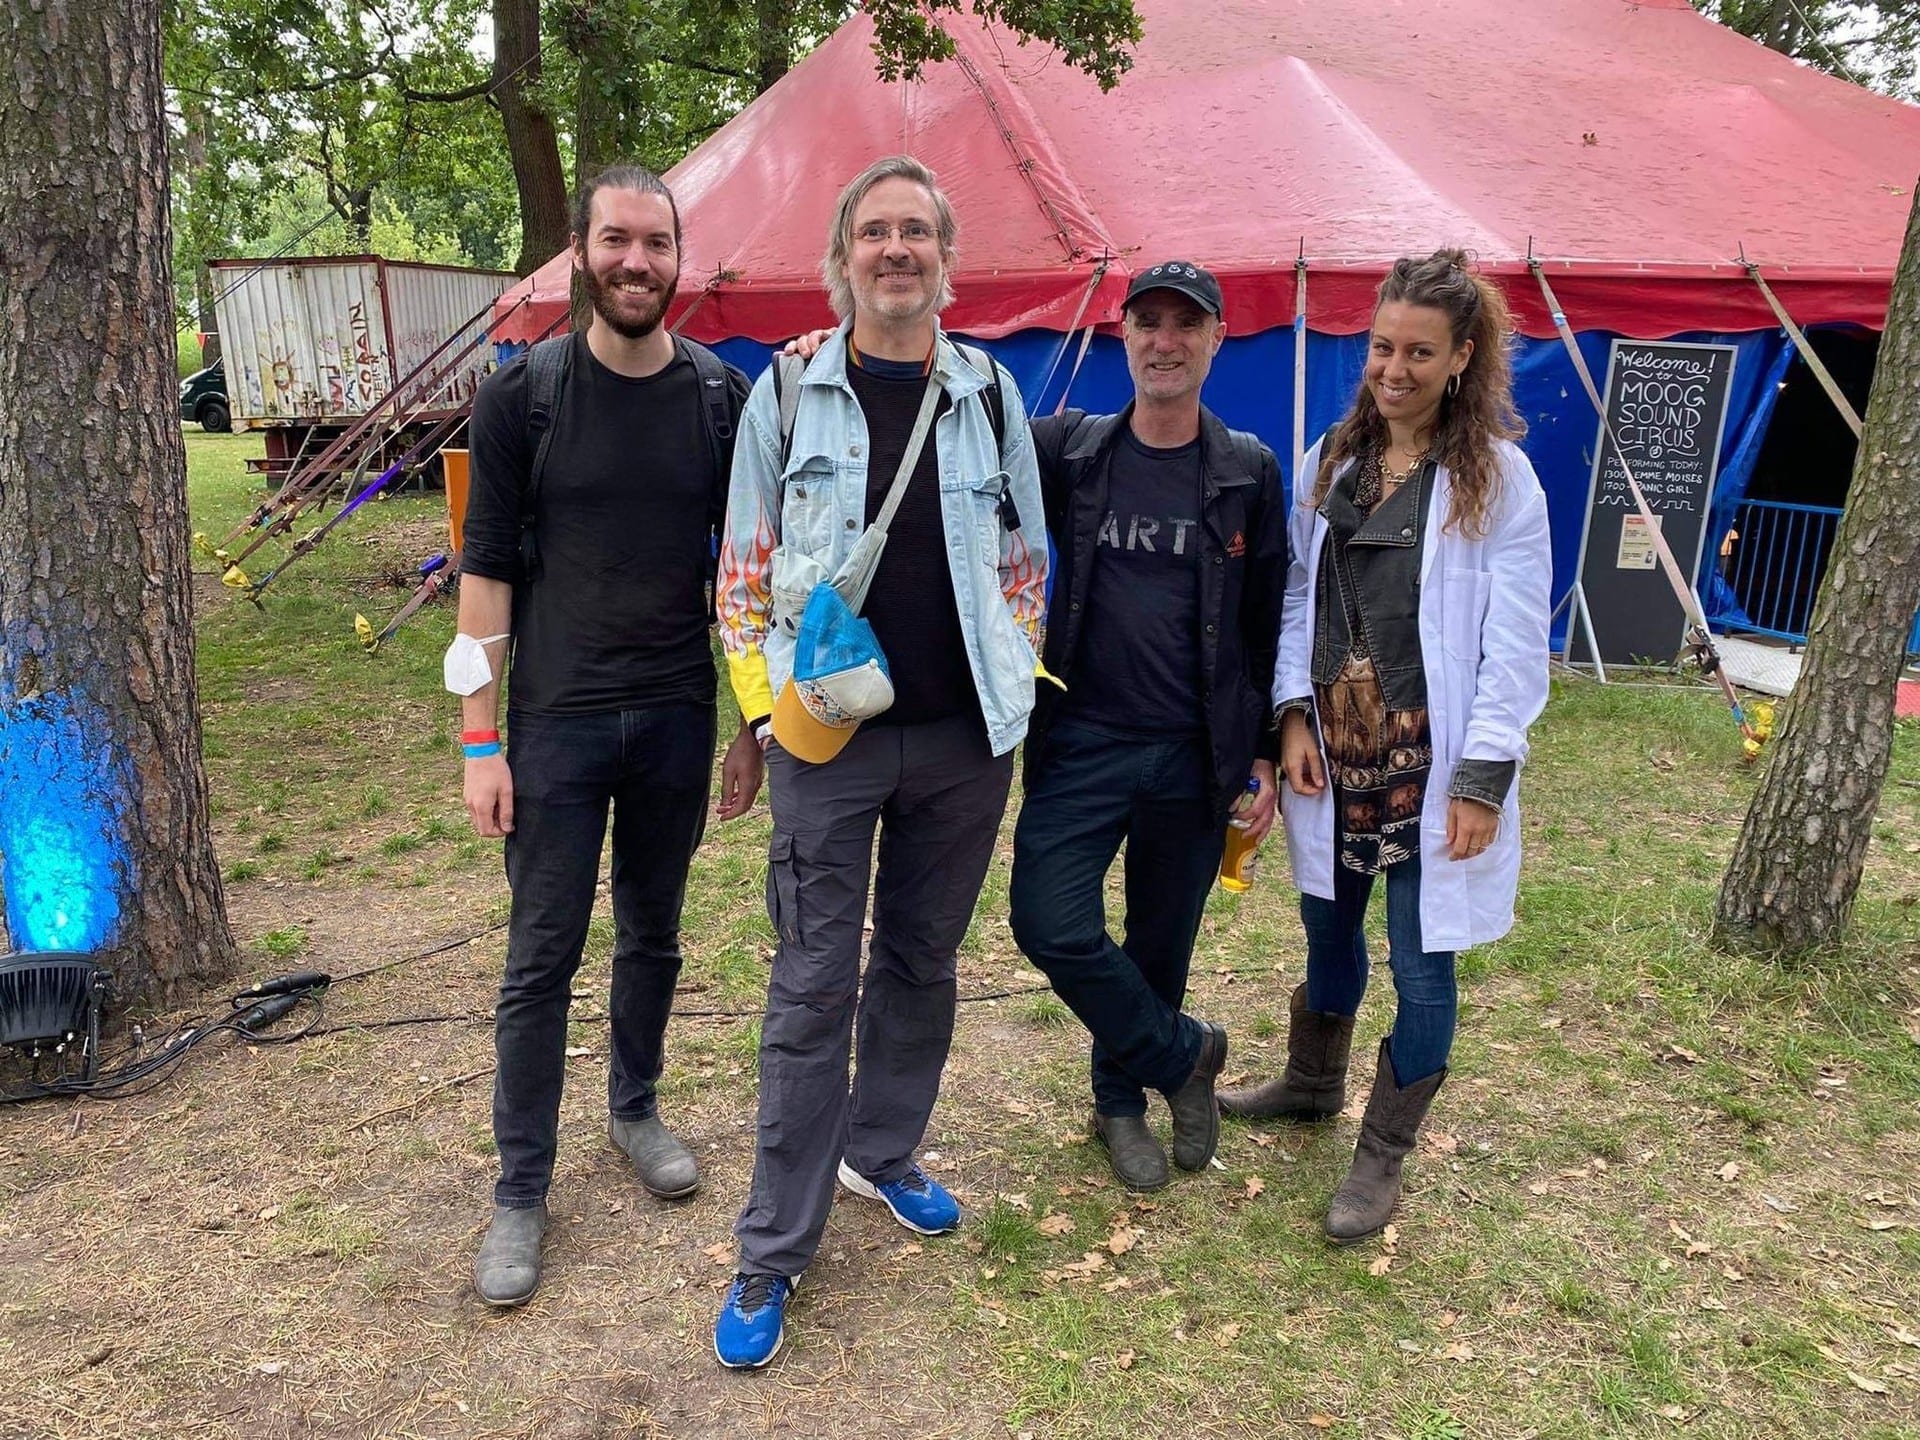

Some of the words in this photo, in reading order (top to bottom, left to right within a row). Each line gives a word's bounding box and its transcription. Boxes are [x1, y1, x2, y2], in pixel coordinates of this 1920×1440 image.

[1617, 350, 1716, 374] Welcome!
[1655, 371, 1673, 380] to
[1620, 381, 1706, 407] MOOG
[1618, 403, 1701, 429] SOUND
[1617, 424, 1695, 449] CIRCUS
[1607, 457, 1665, 469] PEFORMING
[1669, 460, 1703, 471] TODAY:
[1634, 471, 1662, 480] EMME
[1665, 472, 1703, 484] MOISES
[1666, 484, 1693, 494] GIRL
[1096, 510, 1198, 555] ART
